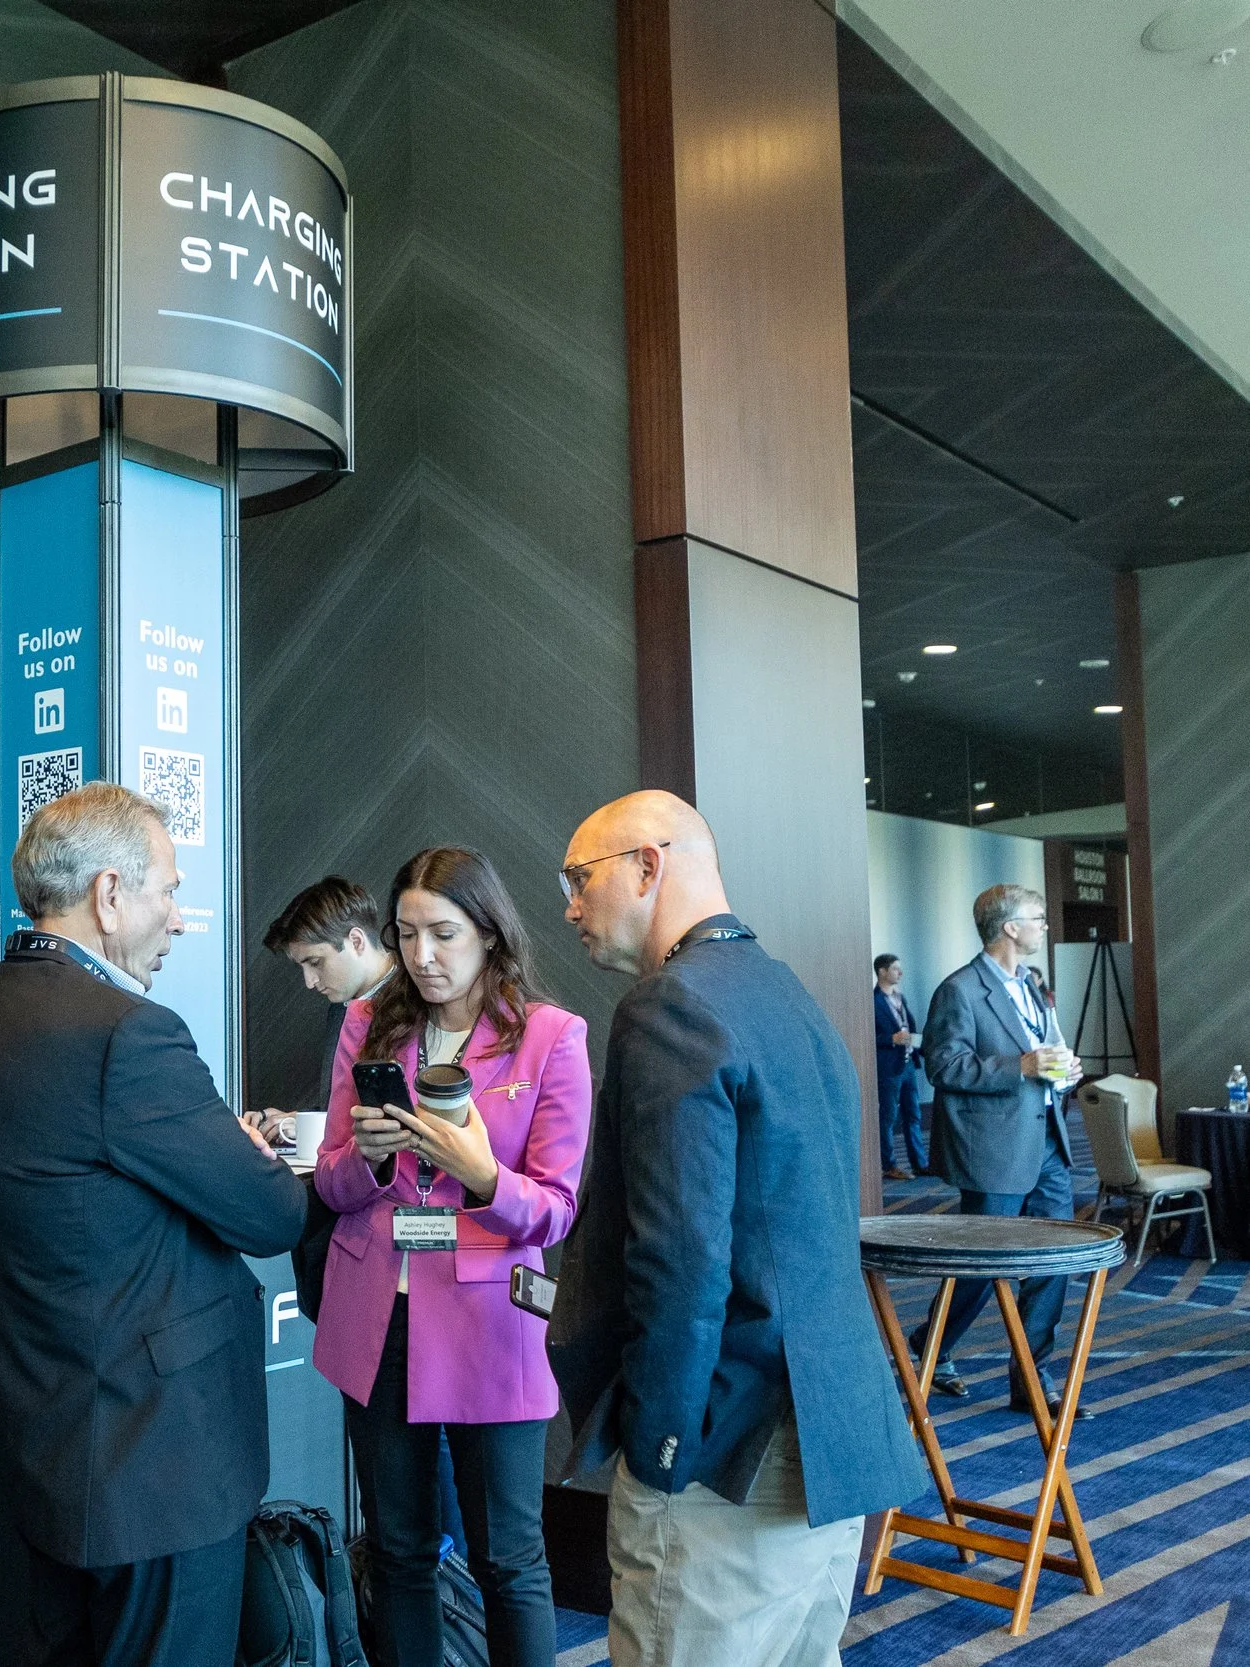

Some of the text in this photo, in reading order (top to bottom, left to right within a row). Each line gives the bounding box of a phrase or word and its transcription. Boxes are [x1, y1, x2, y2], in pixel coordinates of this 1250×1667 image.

[160, 172, 342, 286] CHARGING
[181, 236, 339, 335] STATION
[18, 627, 83, 656] Follow
[139, 619, 205, 655] Follow
[24, 654, 76, 679] us on
[145, 653, 198, 679] us on
[29, 940, 58, 950] SAF
